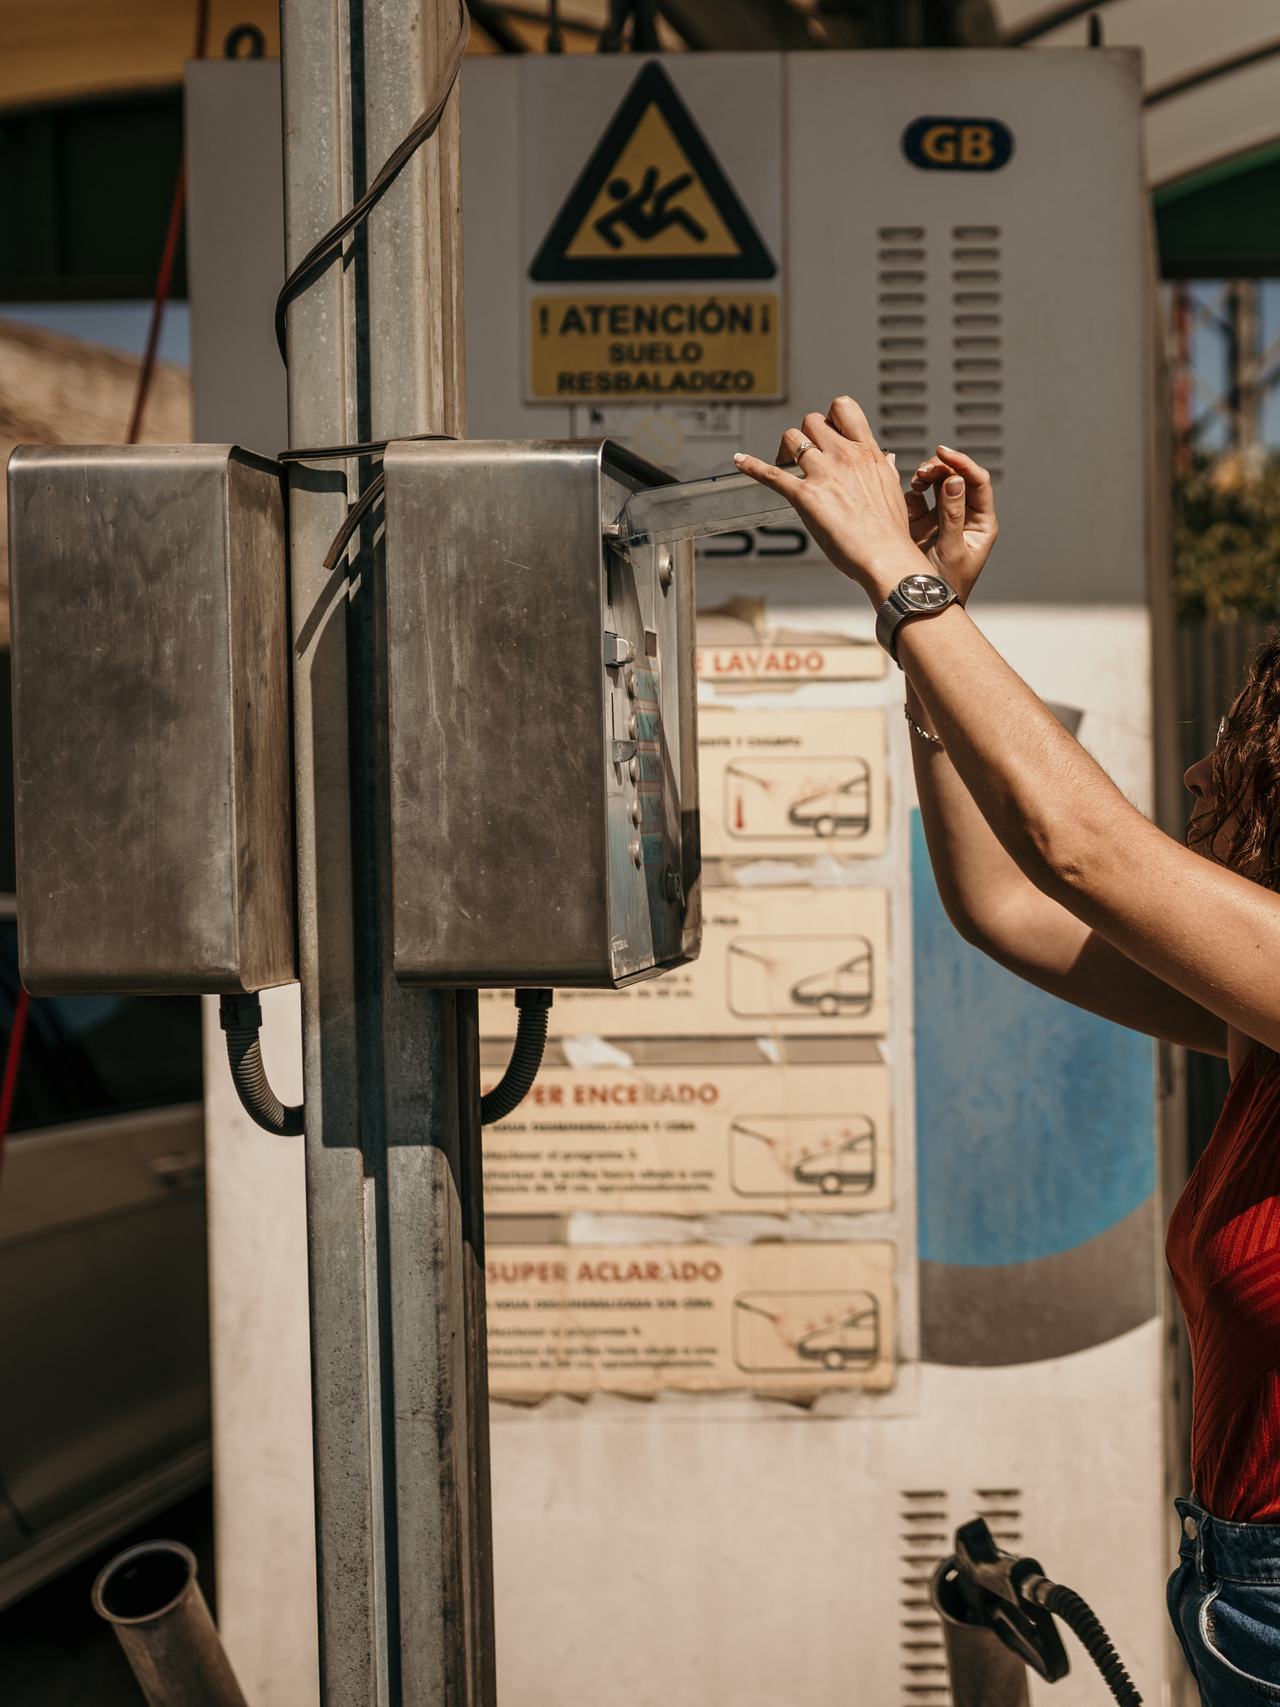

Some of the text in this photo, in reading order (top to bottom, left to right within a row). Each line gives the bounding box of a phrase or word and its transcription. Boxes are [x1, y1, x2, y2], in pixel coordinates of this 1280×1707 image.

[921, 126, 995, 163] GB
[559, 297, 753, 336] ATENCIÓN
[609, 342, 704, 365] SUELO
[557, 370, 755, 393] RESBALADIZO
[713, 650, 824, 673] LAVADO
[573, 1083, 719, 1107] ENCERADO
[486, 1260, 722, 1285] SUPER ACLARADO
